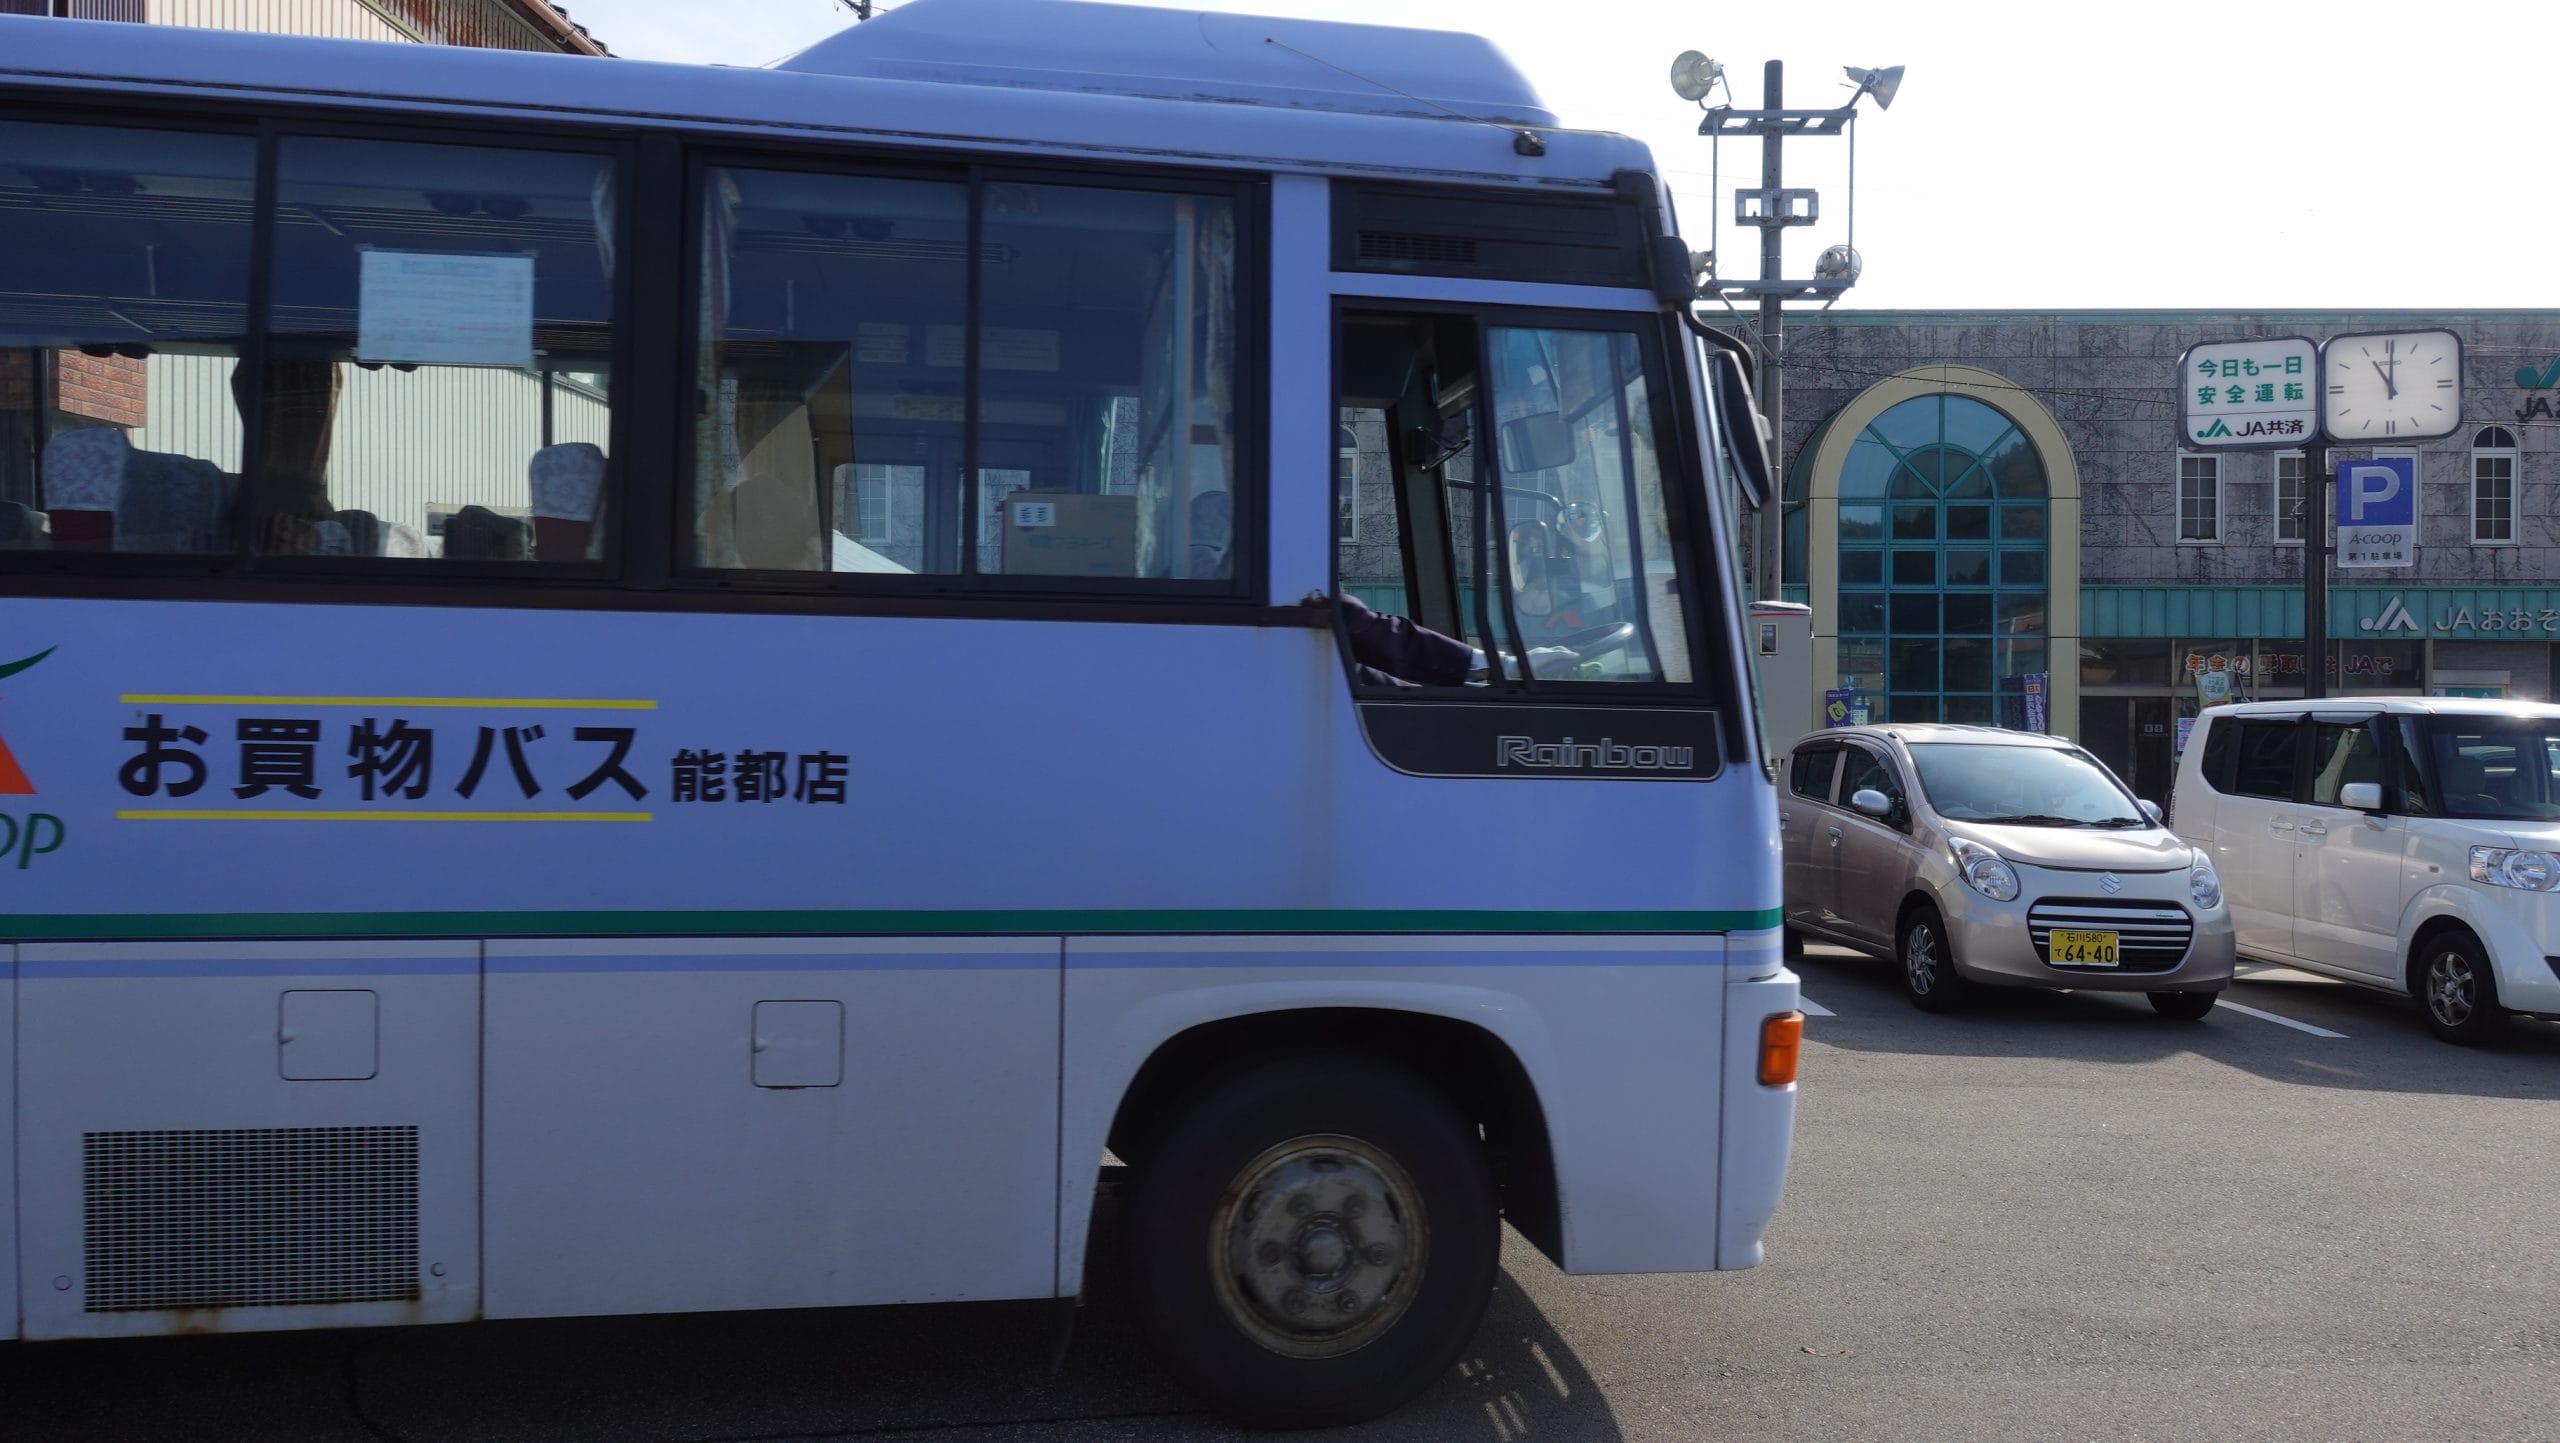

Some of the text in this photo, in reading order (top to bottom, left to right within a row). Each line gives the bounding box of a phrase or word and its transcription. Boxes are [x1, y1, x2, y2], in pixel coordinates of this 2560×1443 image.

[2198, 356, 2302, 378] 今日も一日
[2197, 383, 2304, 405] 安全運転
[2236, 419, 2304, 437] JA共済
[2351, 466, 2400, 520] P
[2348, 551, 2402, 561] 第1駐車場
[118, 713, 849, 804] お買物バス 能都店
[1496, 735, 1694, 770] Rainbow
[2054, 945, 2114, 962] て 64-40
